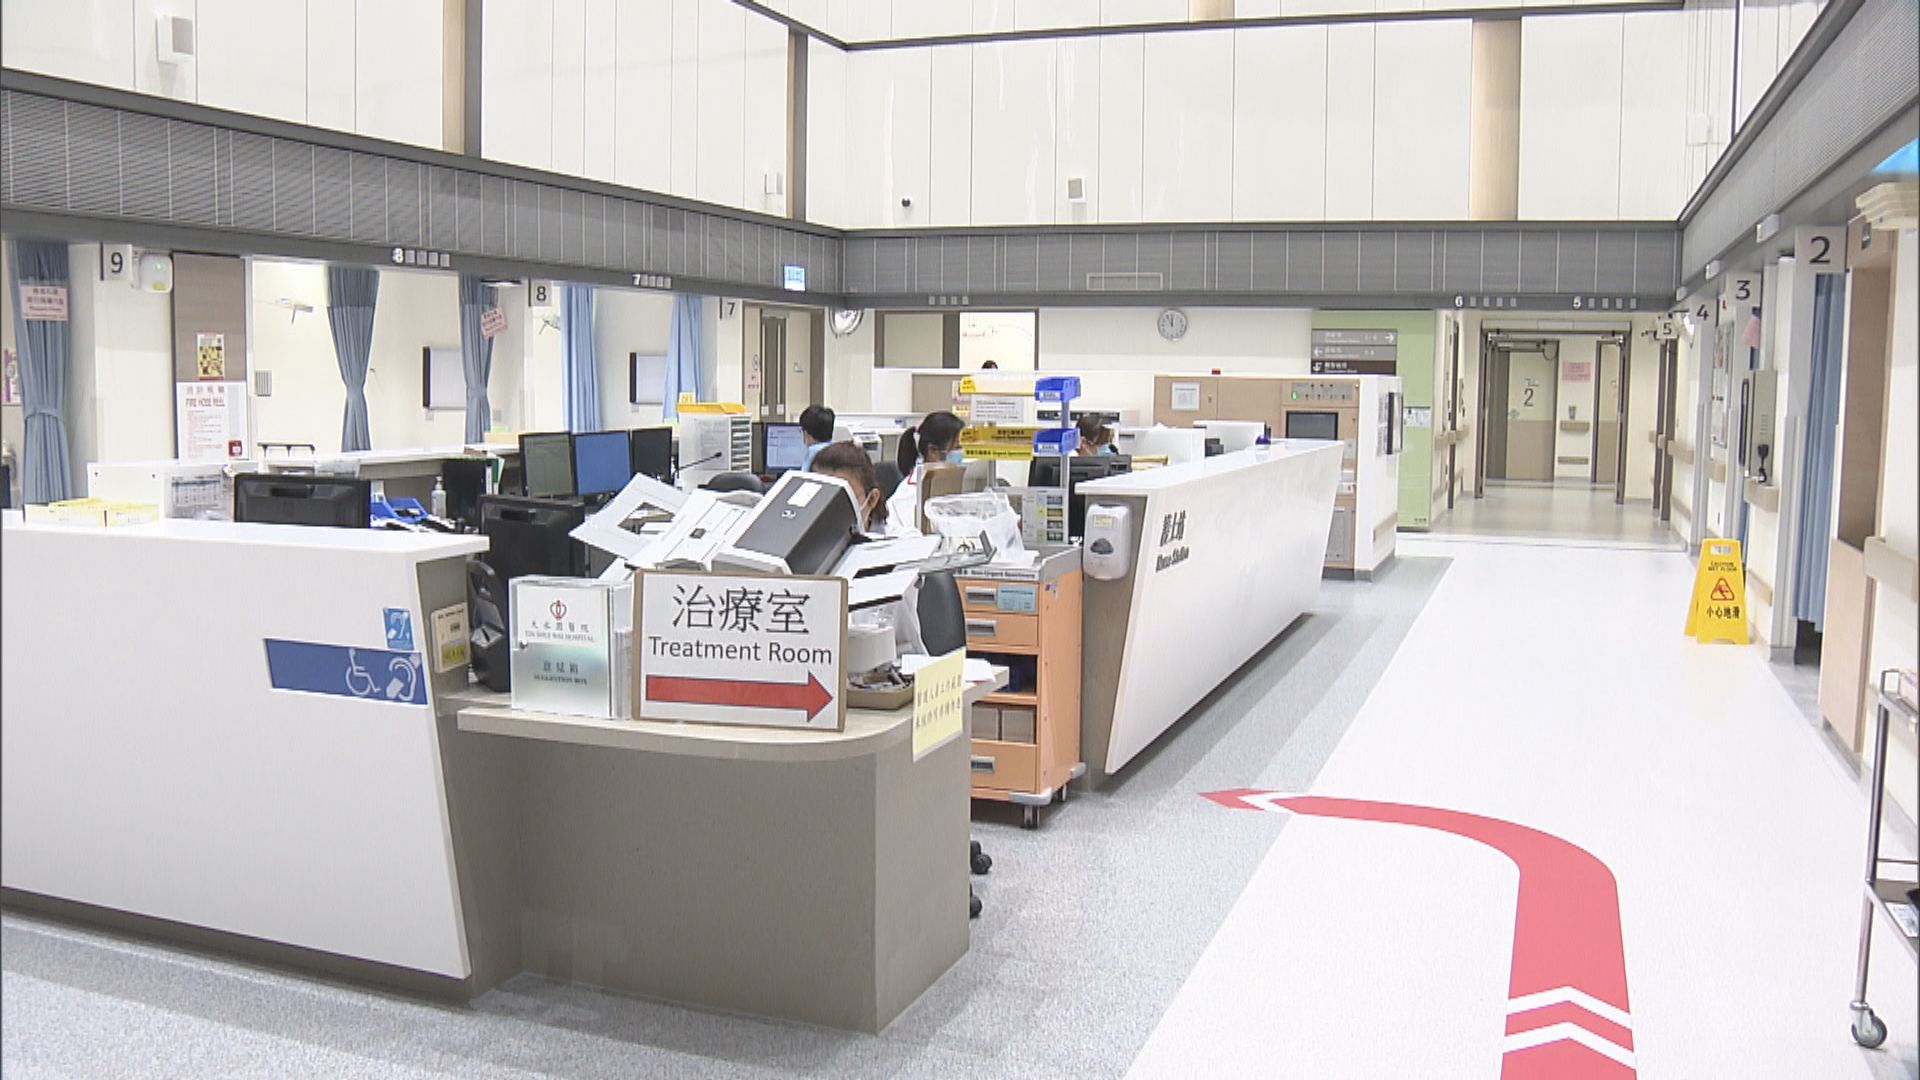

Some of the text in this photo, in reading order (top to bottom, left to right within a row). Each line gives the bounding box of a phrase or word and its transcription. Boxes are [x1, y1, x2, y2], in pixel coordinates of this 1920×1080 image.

[1809, 236, 1831, 264] 2
[111, 251, 123, 273] 9
[632, 274, 641, 286] 7
[536, 286, 547, 301] 8
[1735, 280, 1751, 300] 3
[727, 302, 736, 316] 7
[1696, 304, 1709, 320] 4
[1662, 323, 1673, 335] 5
[1524, 387, 1534, 407] 2
[672, 583, 811, 635] 治療室
[1706, 605, 1740, 619] 小心地滑
[648, 636, 832, 664] Treatment Room
